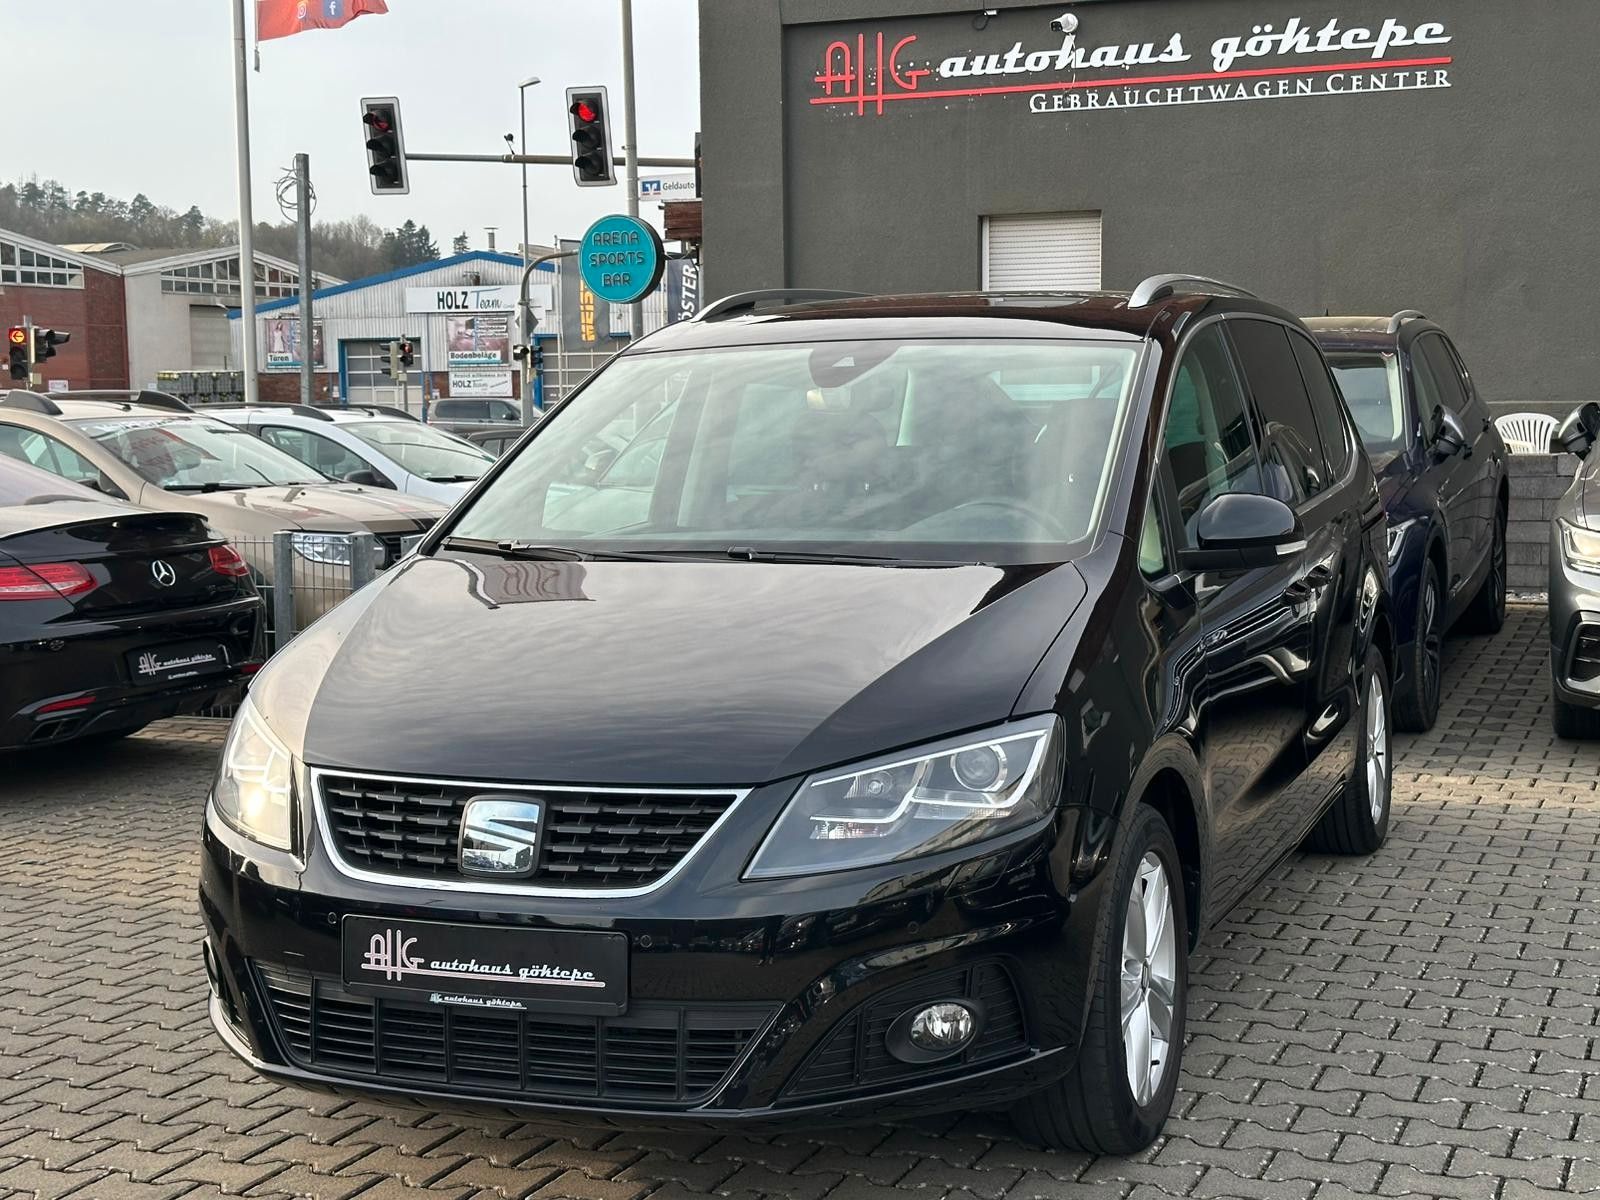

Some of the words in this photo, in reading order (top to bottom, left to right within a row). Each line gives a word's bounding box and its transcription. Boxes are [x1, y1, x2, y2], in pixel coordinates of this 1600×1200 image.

[939, 33, 1192, 78] autohaus
[1210, 17, 1453, 73] göktepe
[1326, 69, 1453, 93] CENTER
[592, 230, 639, 247] ARENA
[588, 251, 645, 267] SPORTS
[601, 272, 631, 287] BAR
[437, 291, 469, 310] HOLZ
[452, 380, 472, 388] HOLZ
[363, 928, 425, 982] AHG
[430, 959, 514, 976] autohaus
[518, 963, 597, 982] göktepe
